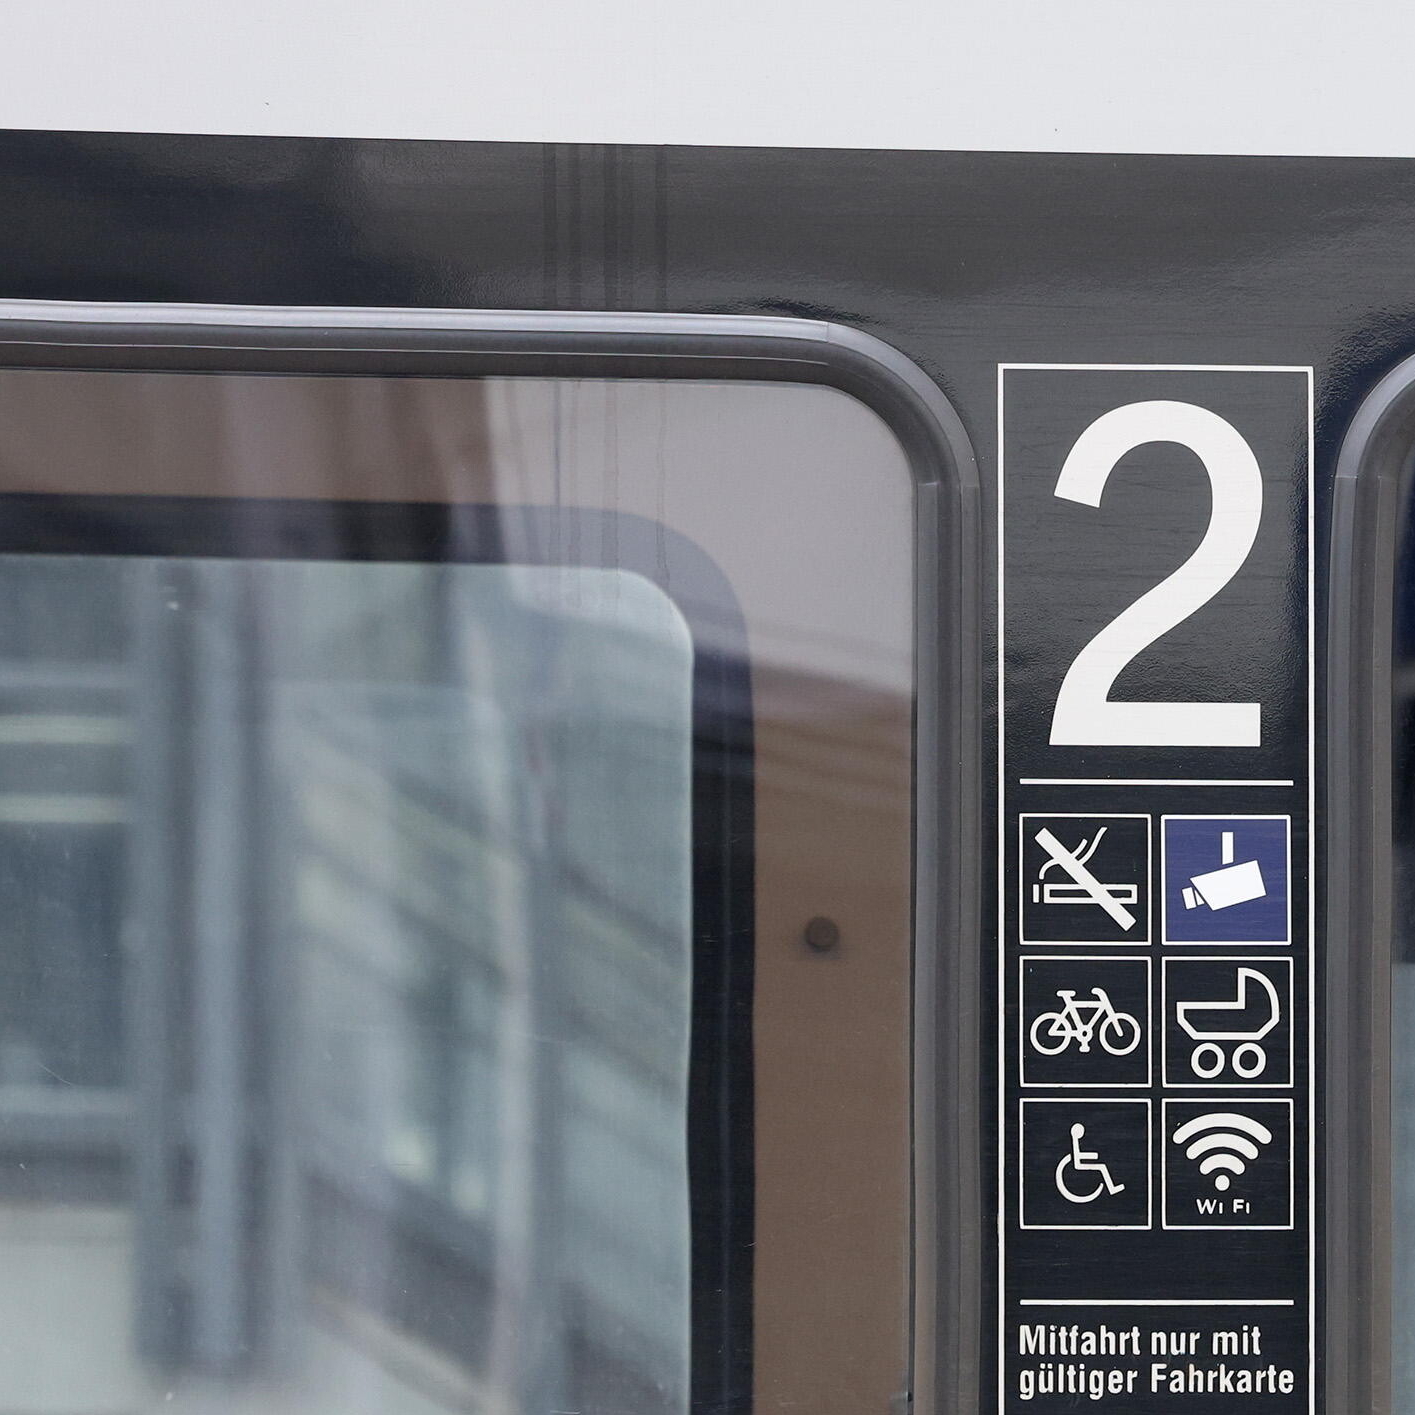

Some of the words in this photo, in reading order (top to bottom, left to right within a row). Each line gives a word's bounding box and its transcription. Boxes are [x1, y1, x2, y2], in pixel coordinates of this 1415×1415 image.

[1048, 399, 1264, 748] 2
[1019, 1324, 1141, 1356] Mitfahrt
[1150, 1330, 1201, 1356] nur
[1212, 1324, 1262, 1356] mit
[1019, 1362, 1138, 1400] gültiger
[1150, 1362, 1295, 1394] Fahrkarte
